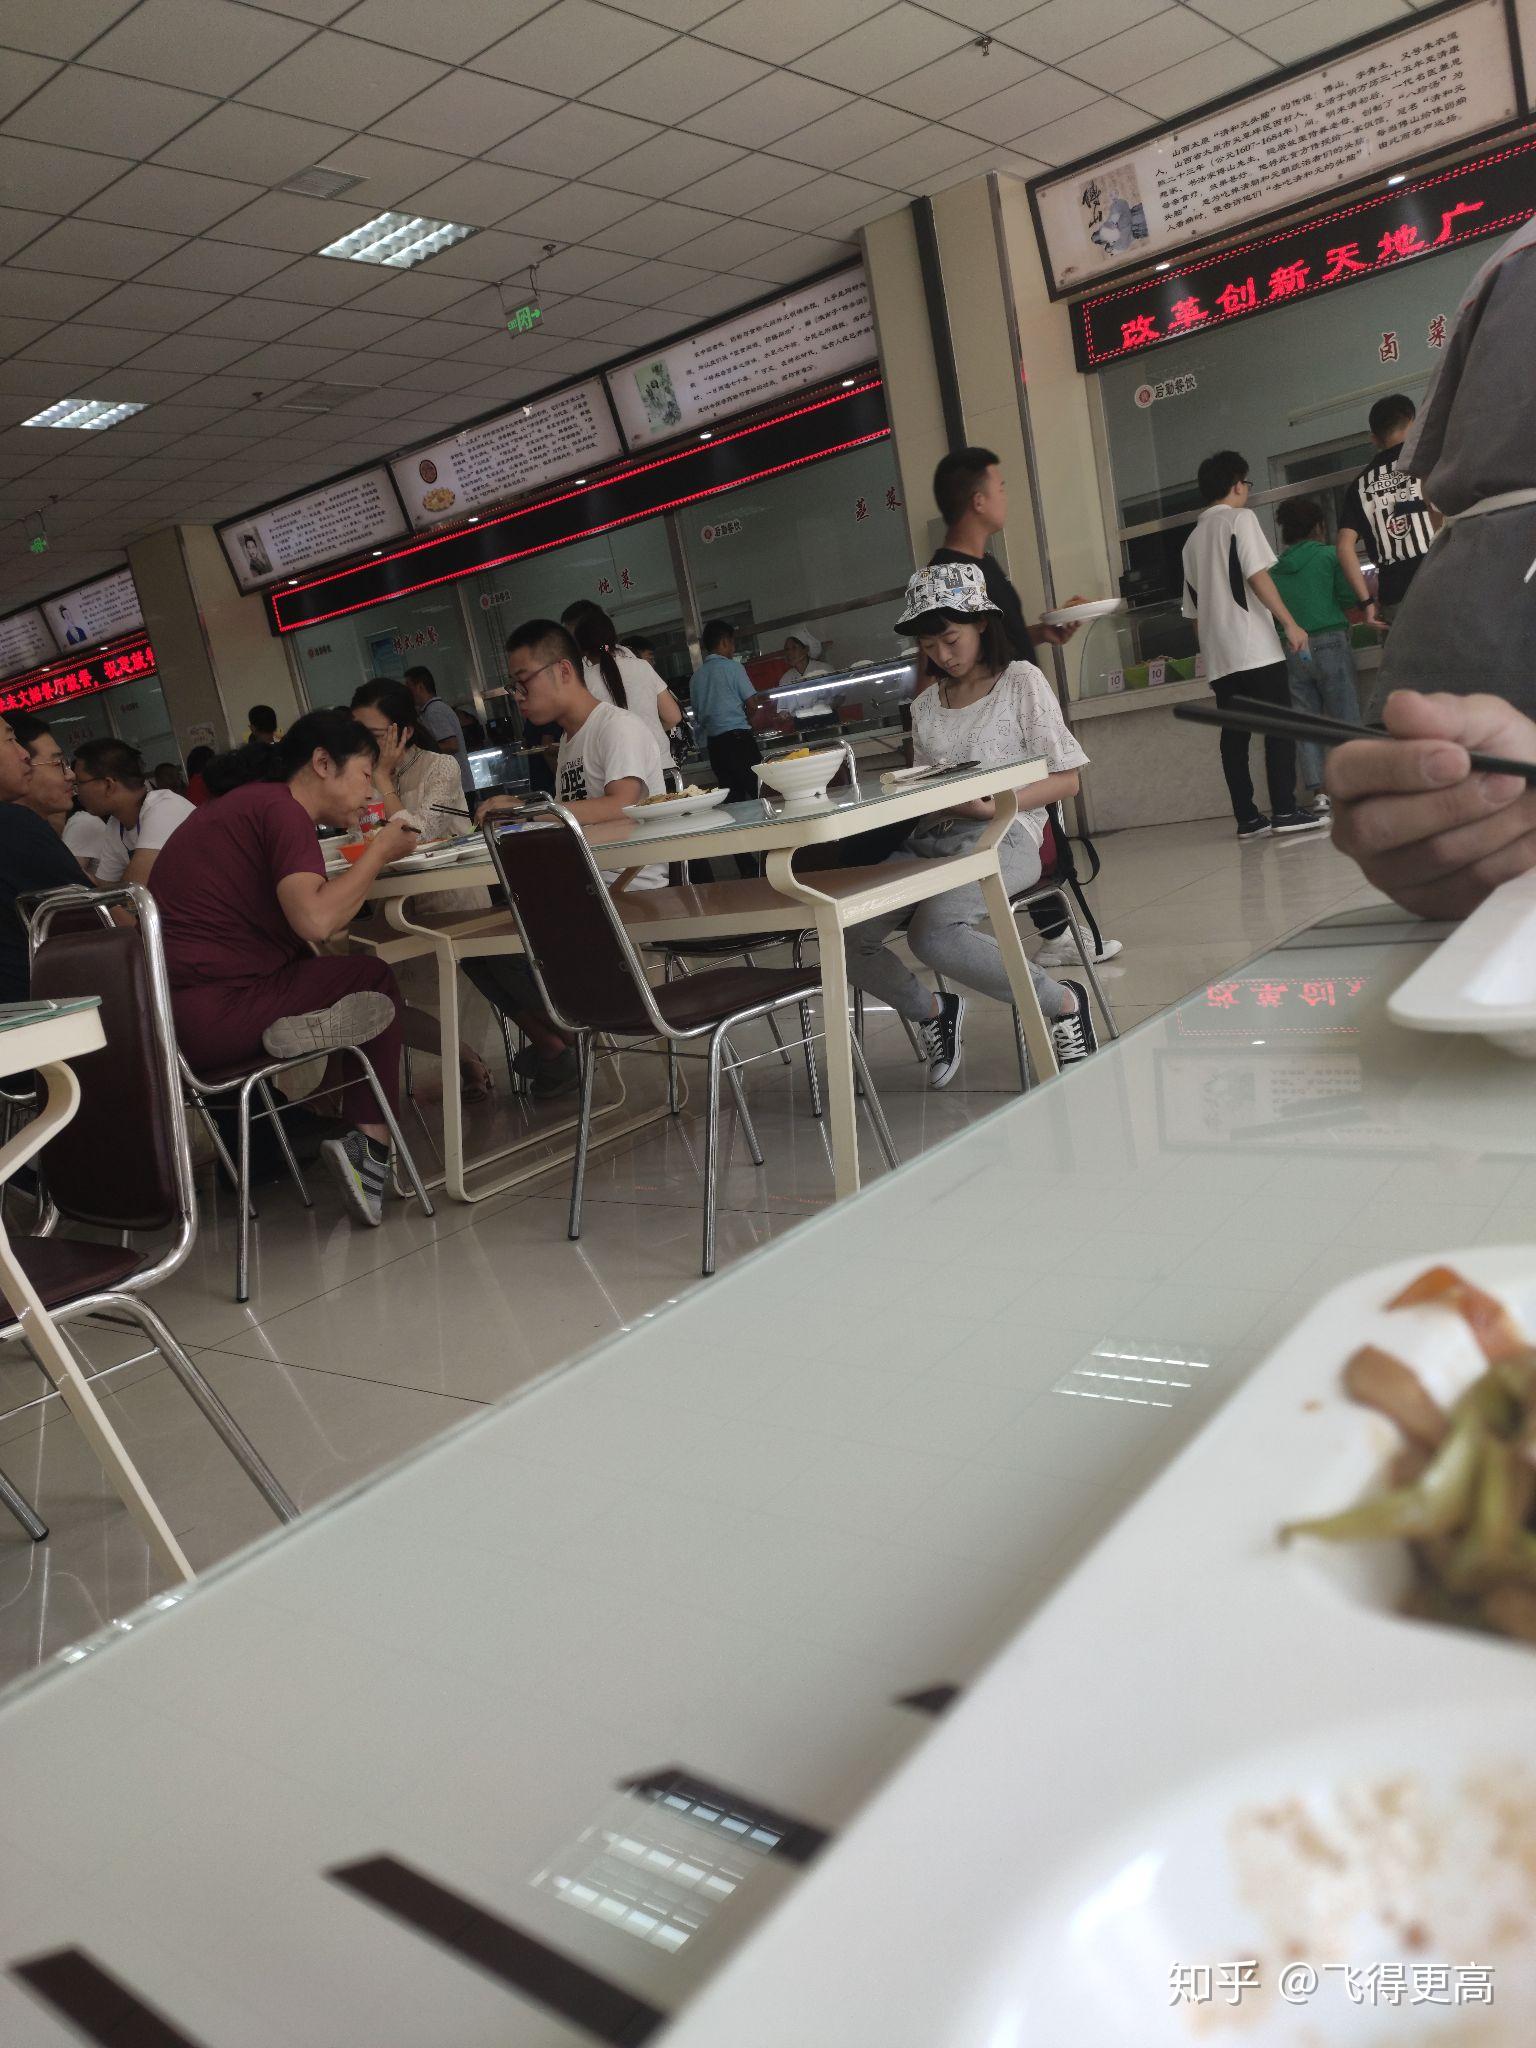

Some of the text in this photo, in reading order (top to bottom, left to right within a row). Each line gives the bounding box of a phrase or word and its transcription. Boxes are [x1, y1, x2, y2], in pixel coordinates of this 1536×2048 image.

[1120, 201, 1485, 348] 改革创新天地广
[1380, 315, 1447, 362] 卤菜
[1154, 375, 1197, 399] 后勤餐饮
[1110, 675, 1120, 686] 10
[1152, 668, 1162, 679] 10
